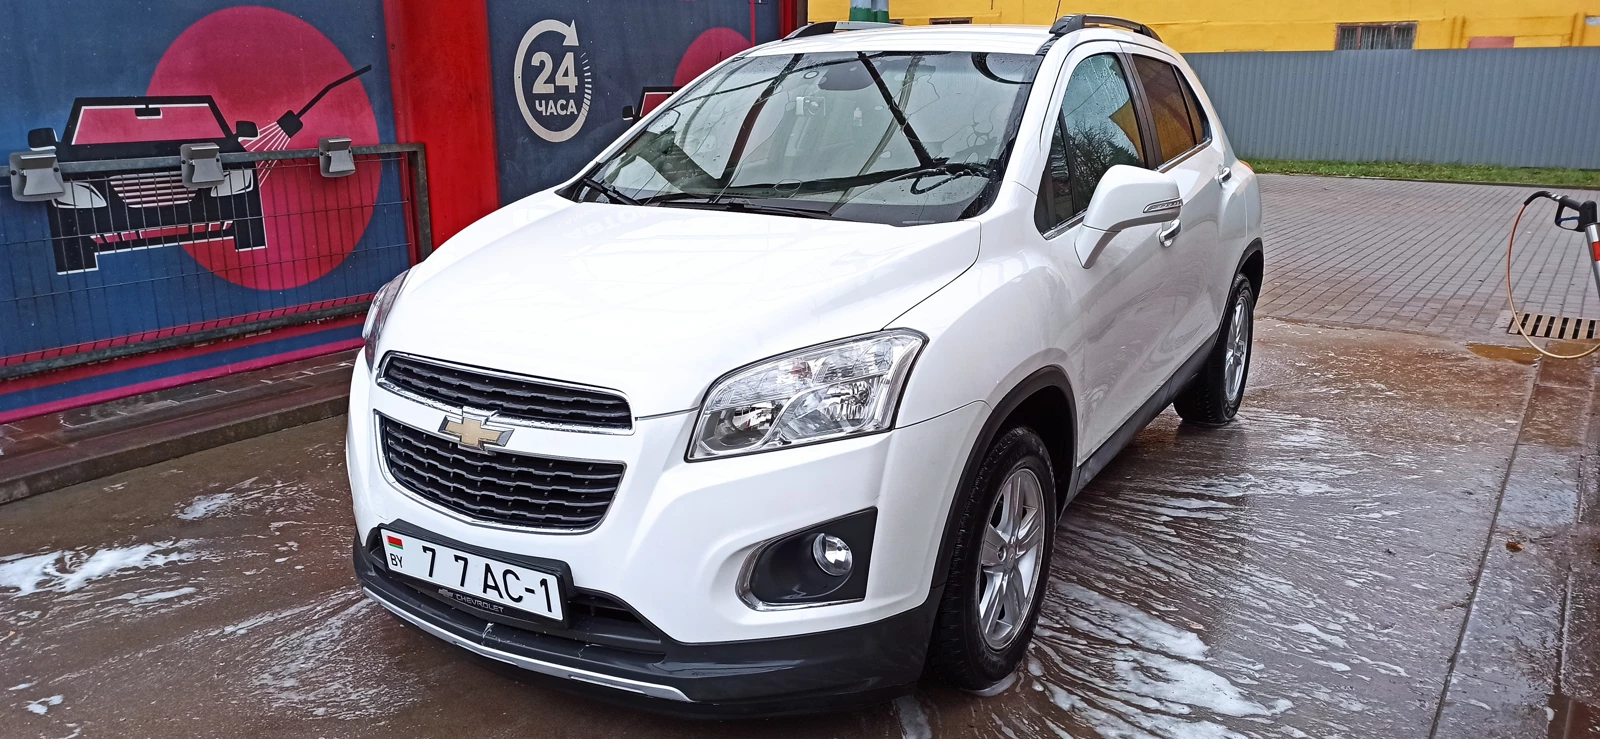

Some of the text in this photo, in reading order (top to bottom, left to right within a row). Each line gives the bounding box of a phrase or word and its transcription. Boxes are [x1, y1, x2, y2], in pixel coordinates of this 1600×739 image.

[531, 51, 578, 94] 24
[535, 99, 578, 116] ЧАСА
[390, 552, 403, 568] BY
[456, 593, 504, 613] CHEVROLET
